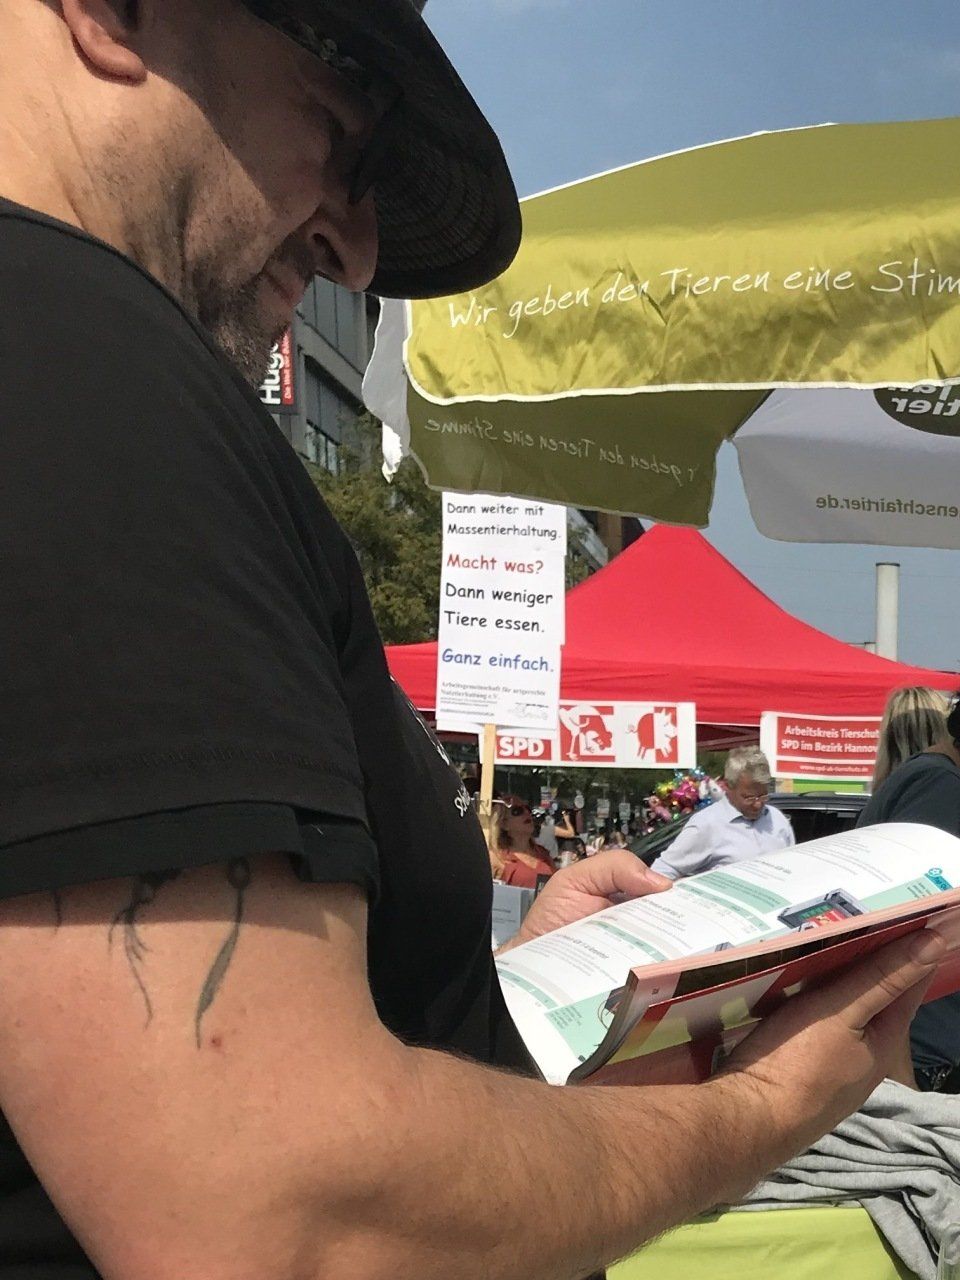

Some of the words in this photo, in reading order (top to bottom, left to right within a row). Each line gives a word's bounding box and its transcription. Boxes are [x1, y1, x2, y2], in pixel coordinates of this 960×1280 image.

[448, 297, 497, 328] Wir
[503, 285, 590, 338] geben
[601, 272, 649, 303] den
[660, 268, 768, 298] Tieren
[783, 267, 855, 292] eine
[447, 503, 476, 514] Dann
[481, 504, 519, 516] weiter
[525, 505, 544, 516] mit
[447, 523, 561, 541] Massentierhaltung.
[446, 554, 497, 570] Macht
[504, 560, 544, 575] was?
[445, 583, 485, 599] Dann
[492, 589, 553, 607] weniger
[444, 611, 487, 627] Tiere
[495, 617, 545, 633] essen.
[442, 649, 481, 666] Ganz
[489, 653, 554, 672] einfach.
[784, 725, 839, 739] Arbeitskreis
[499, 737, 544, 757] SPD
[781, 739, 799, 750] SPD
[801, 742, 813, 750] im
[815, 742, 842, 752] Bezirk
